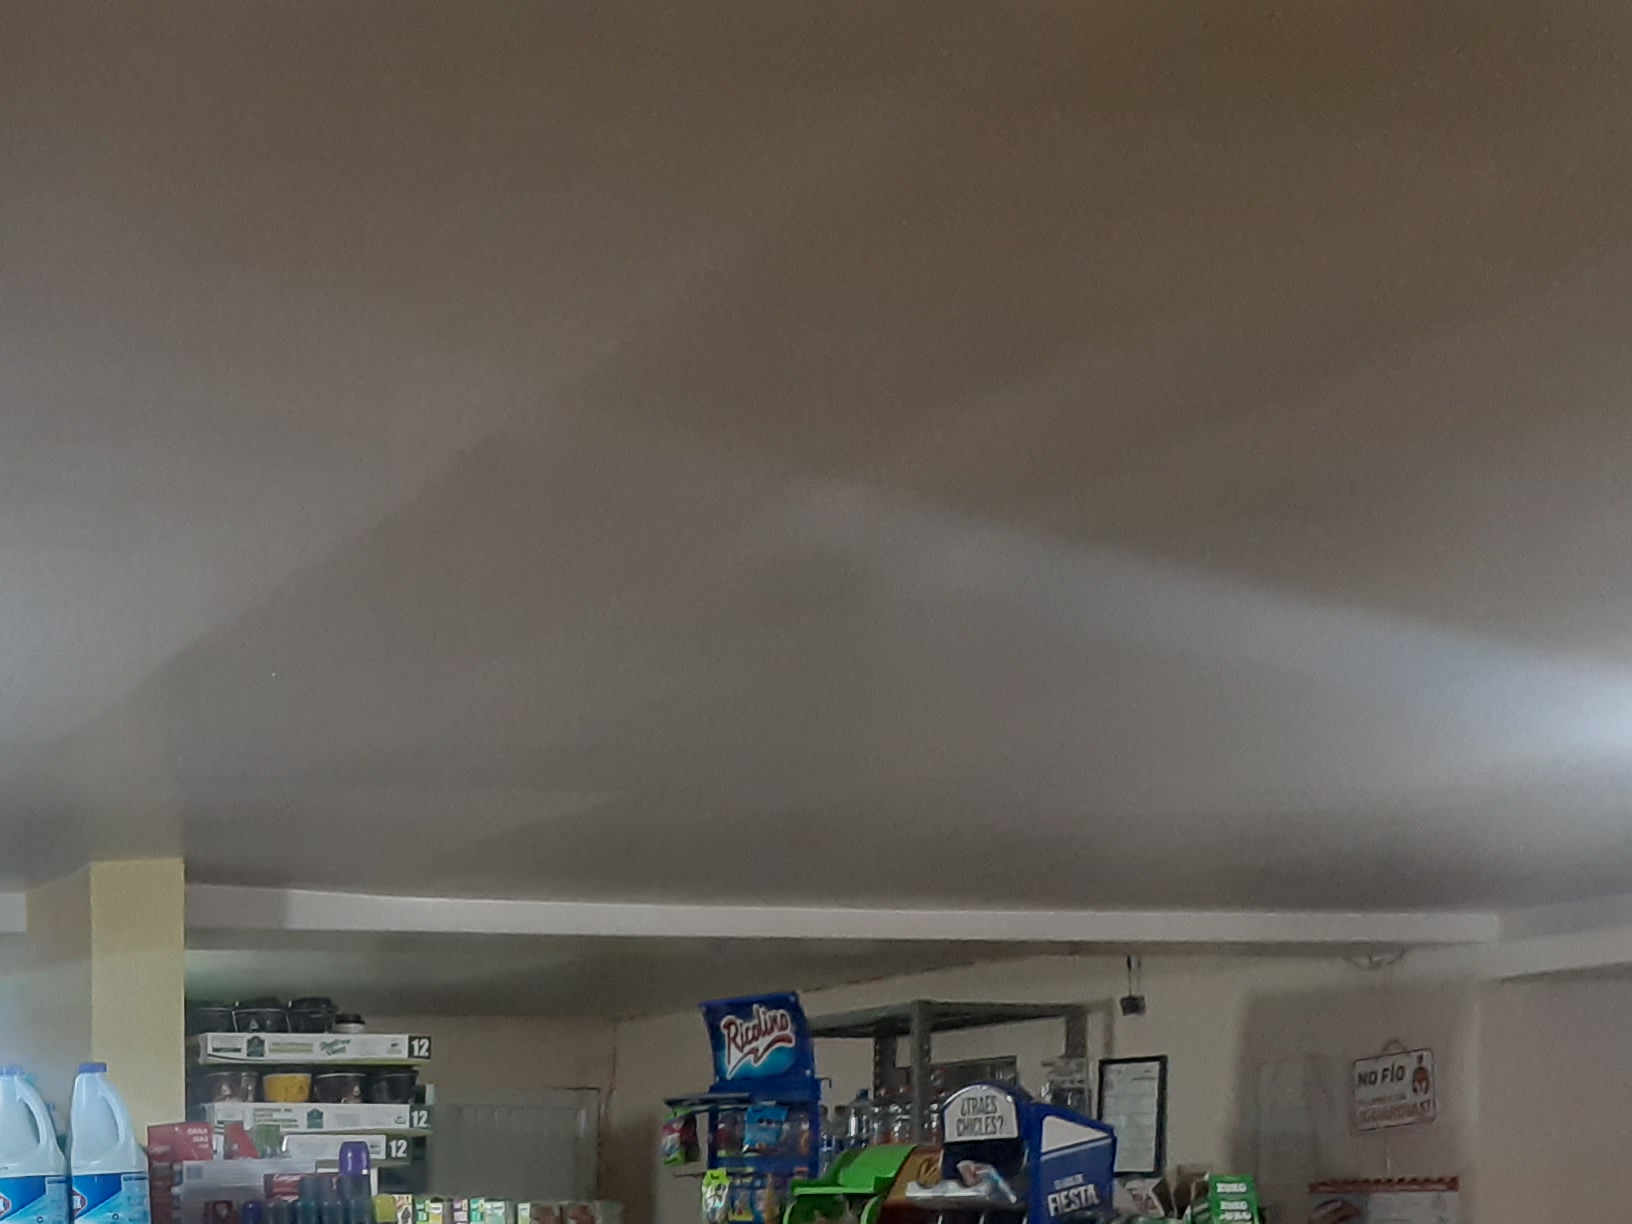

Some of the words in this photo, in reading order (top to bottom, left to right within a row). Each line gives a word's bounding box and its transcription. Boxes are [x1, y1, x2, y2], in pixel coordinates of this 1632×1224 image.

[722, 1006, 790, 1064] Ricolino
[411, 1038, 430, 1058] 12
[1357, 1071, 1378, 1087] NO
[411, 1109, 429, 1128] 12
[388, 1139, 408, 1158] 12
[1047, 1183, 1101, 1218] FIESTA
